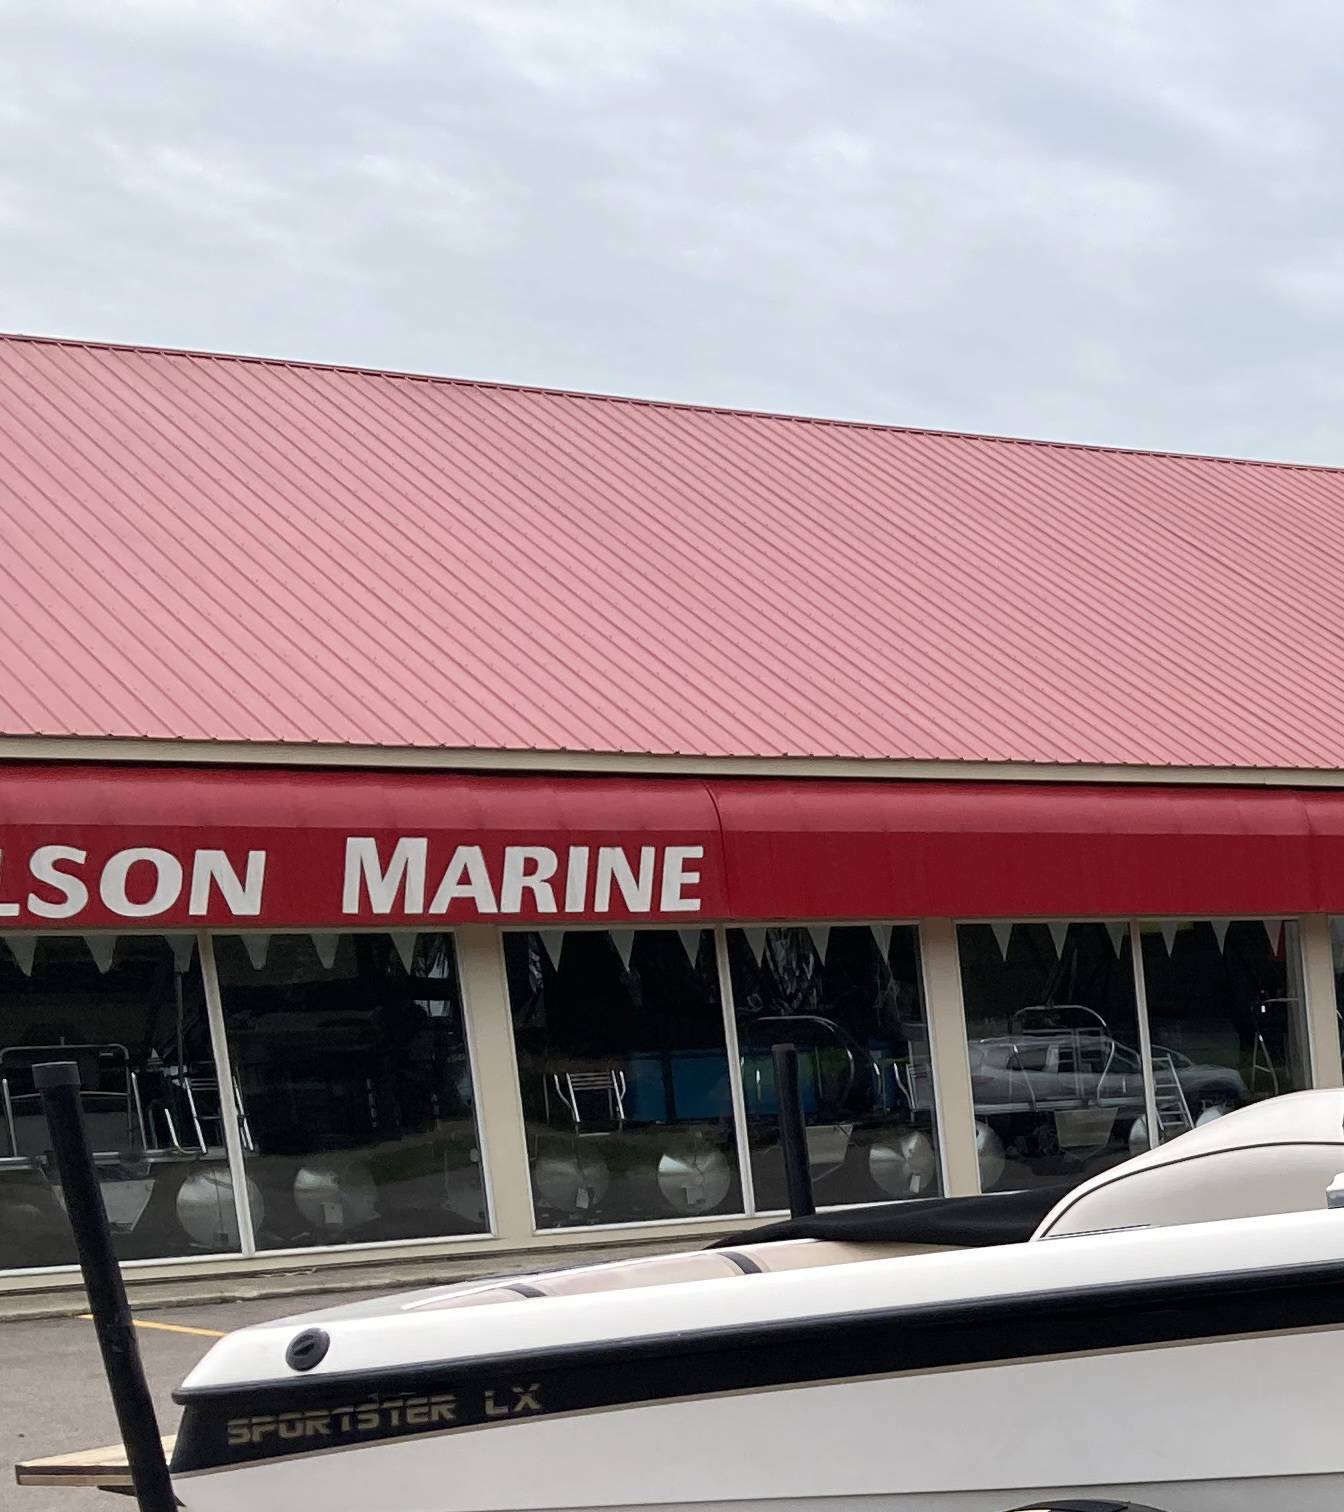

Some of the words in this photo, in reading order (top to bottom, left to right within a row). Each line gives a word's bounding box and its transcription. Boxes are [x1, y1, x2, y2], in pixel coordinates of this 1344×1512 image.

[342, 837, 704, 914] MARINE
[227, 1394, 458, 1445] SPORTSTER
[484, 1384, 543, 1415] LX
